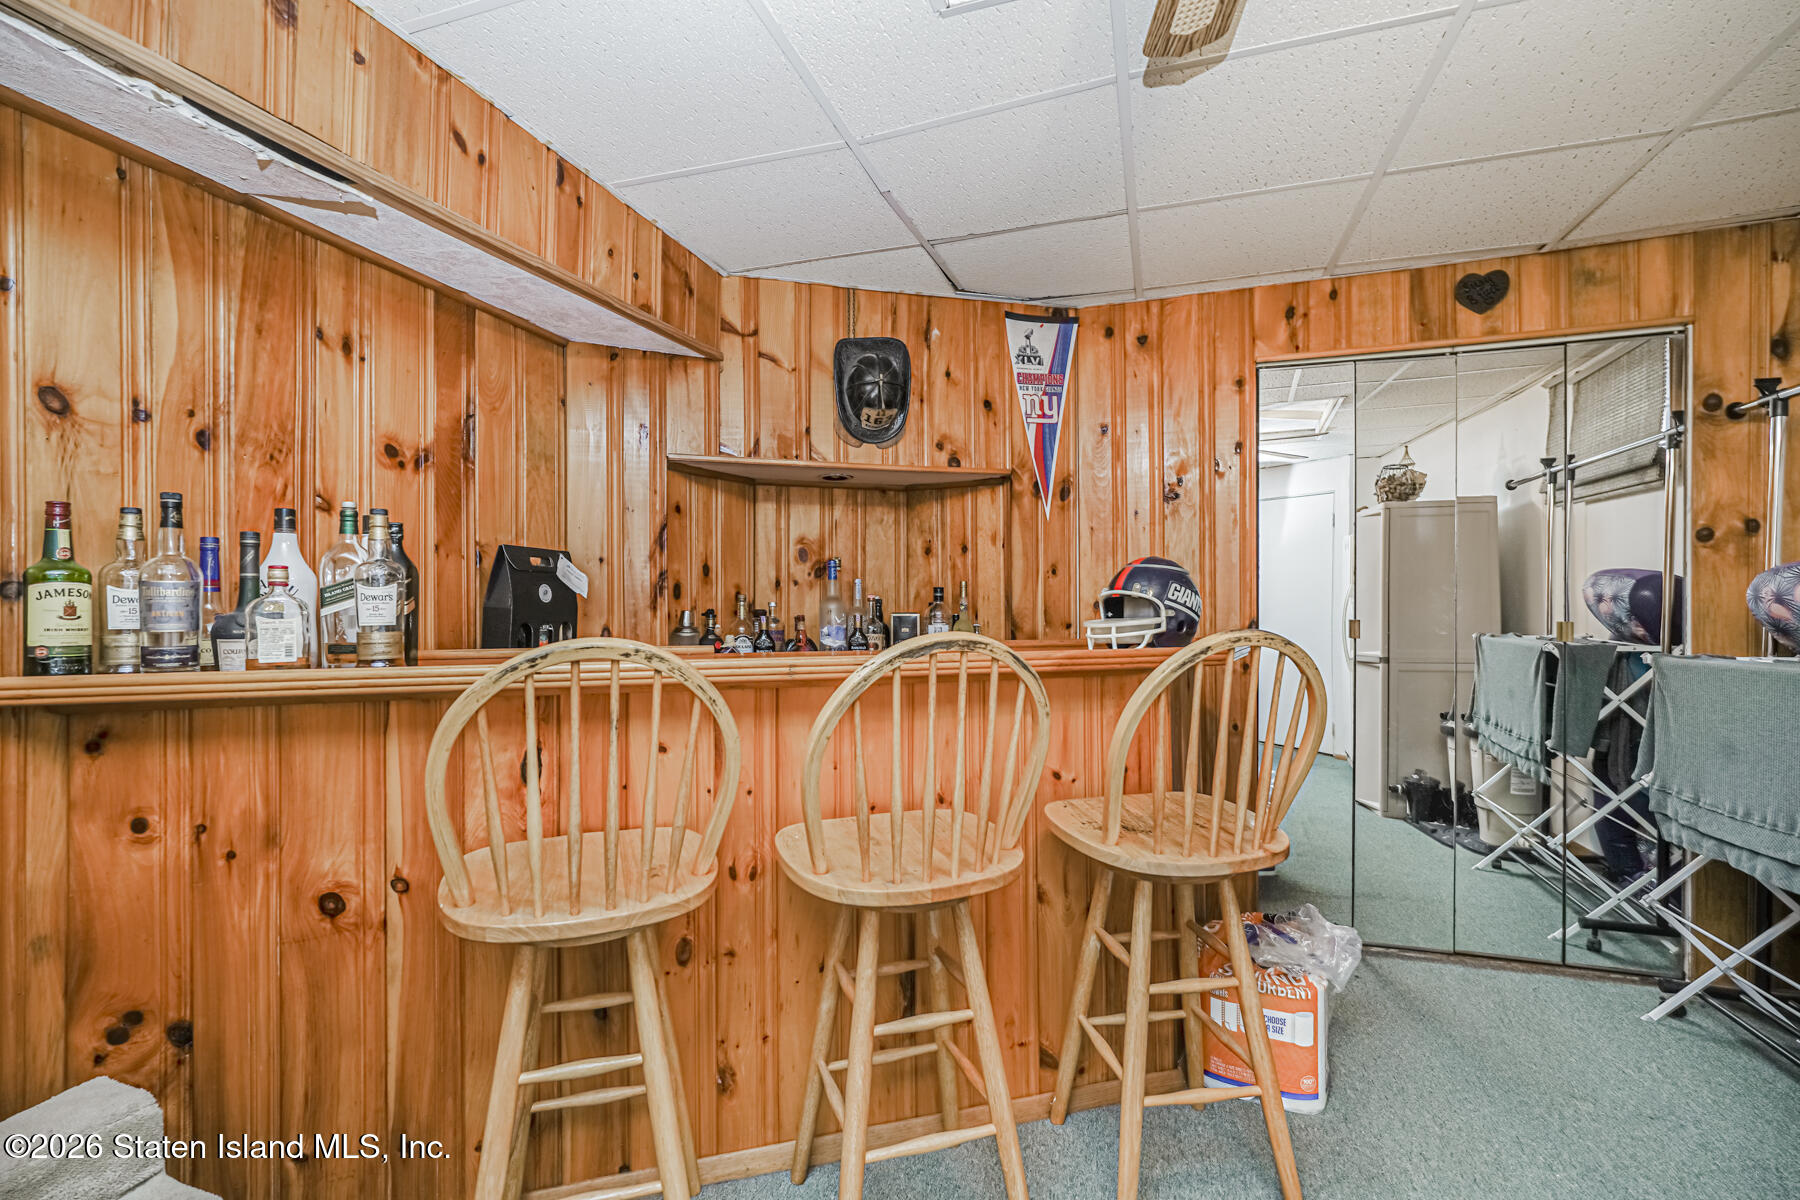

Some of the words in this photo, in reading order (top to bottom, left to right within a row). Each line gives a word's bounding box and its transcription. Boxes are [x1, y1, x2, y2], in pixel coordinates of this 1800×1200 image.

[1017, 372, 1064, 385] CHAMPIONS
[360, 592, 394, 602] Dewar's
[128, 607, 138, 615] 15
[1271, 1025, 1284, 1035] SIZE
